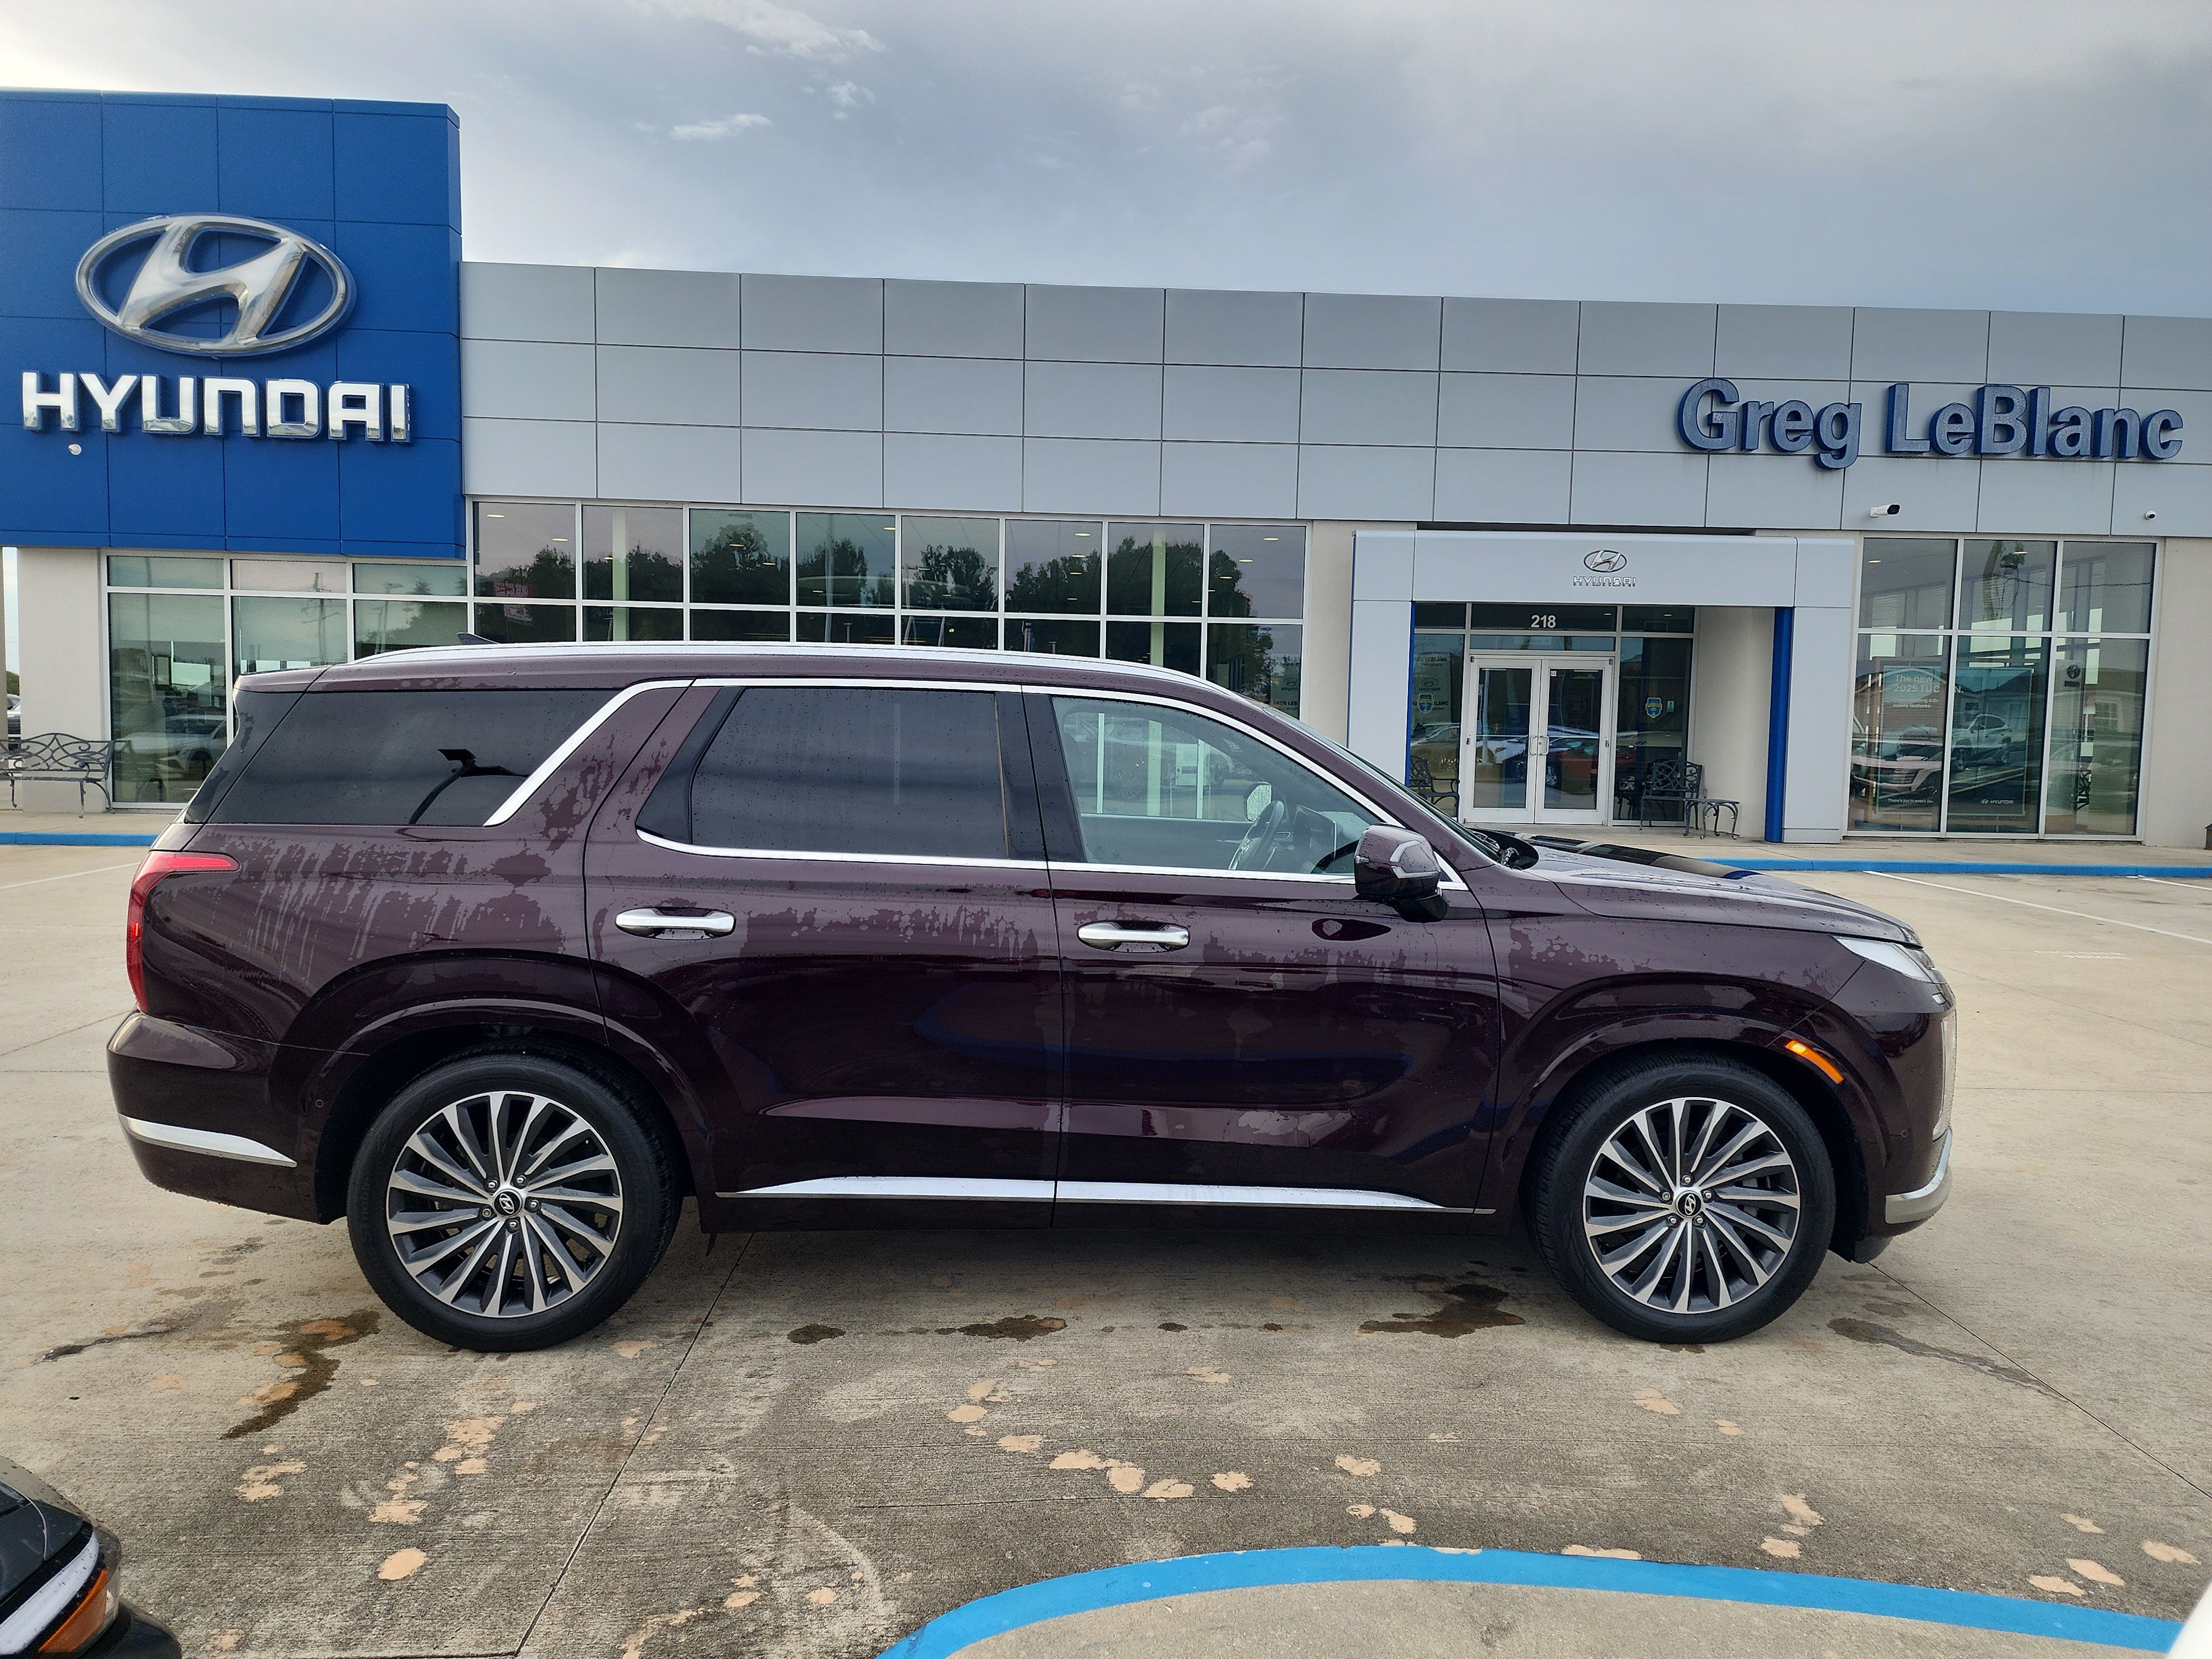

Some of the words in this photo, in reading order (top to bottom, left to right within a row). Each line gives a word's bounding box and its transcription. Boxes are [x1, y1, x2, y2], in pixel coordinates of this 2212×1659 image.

[22, 371, 410, 442] HYUNDAI
[1678, 378, 1862, 470] Greg
[1886, 383, 2183, 460] LeBlanc
[1573, 576, 1636, 587] HYUNDAI
[1531, 615, 1556, 628] 218
[1894, 675, 1911, 683] The
